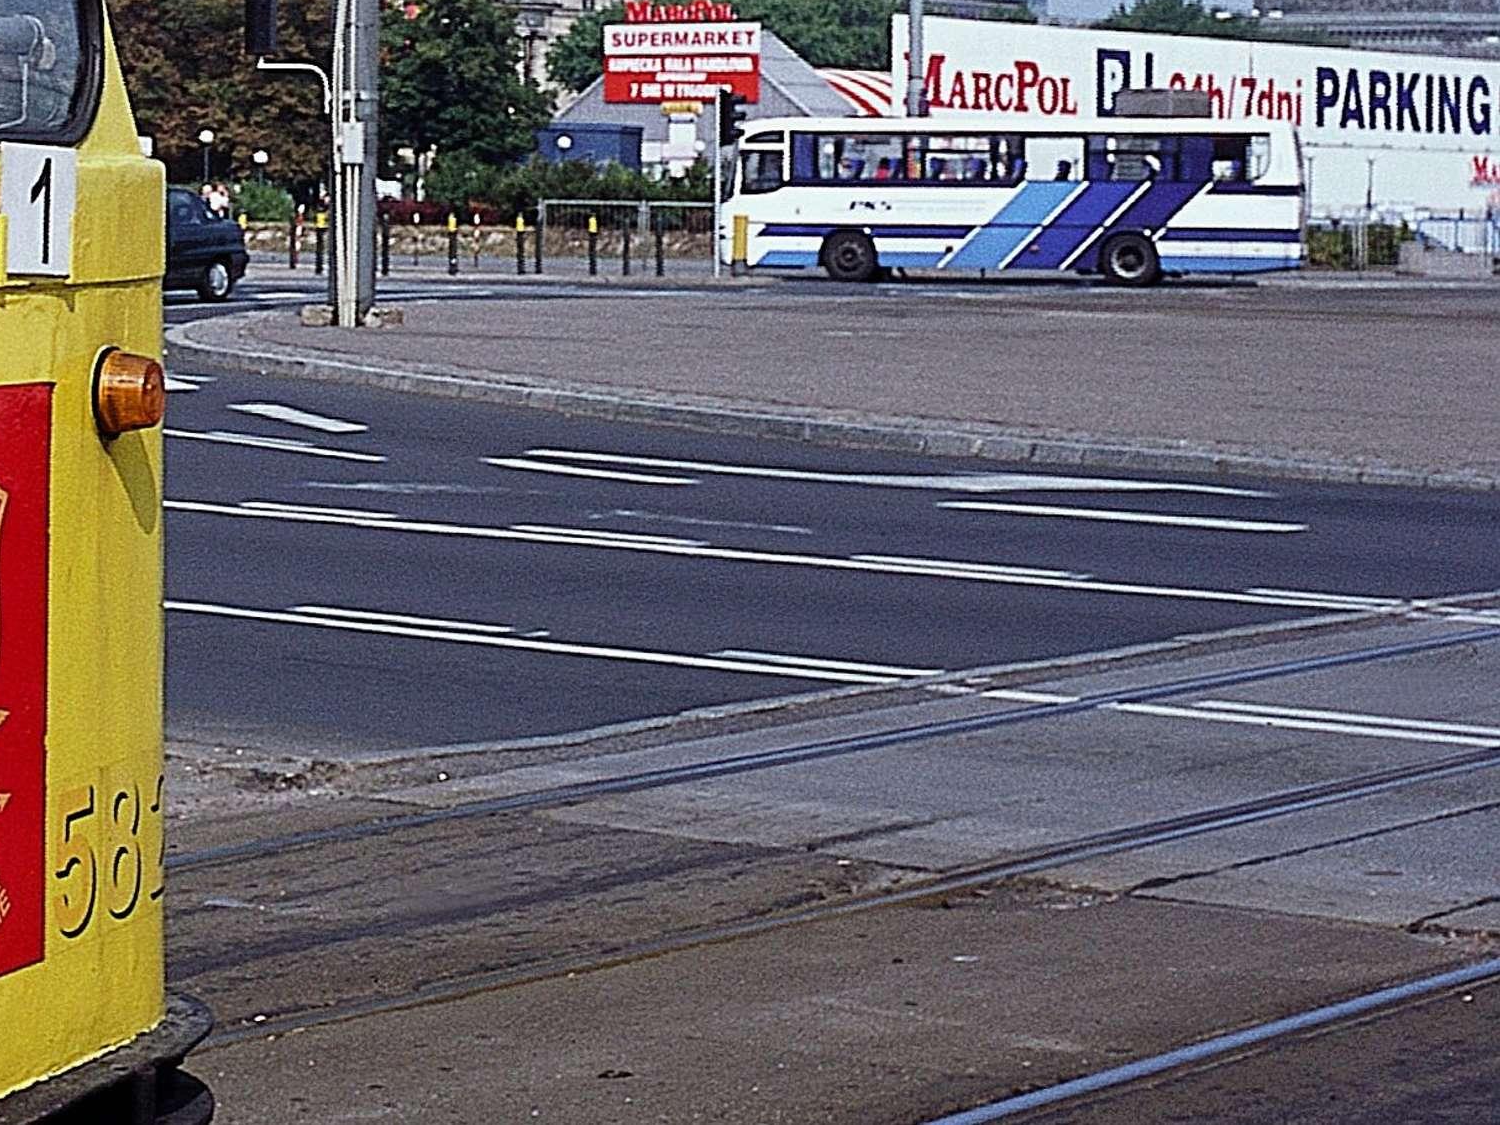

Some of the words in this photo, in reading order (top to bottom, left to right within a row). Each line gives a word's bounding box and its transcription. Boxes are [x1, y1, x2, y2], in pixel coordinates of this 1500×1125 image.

[611, 30, 756, 48] SUPERMARKET
[1316, 67, 1491, 135] PARKING
[31, 157, 52, 265] 1
